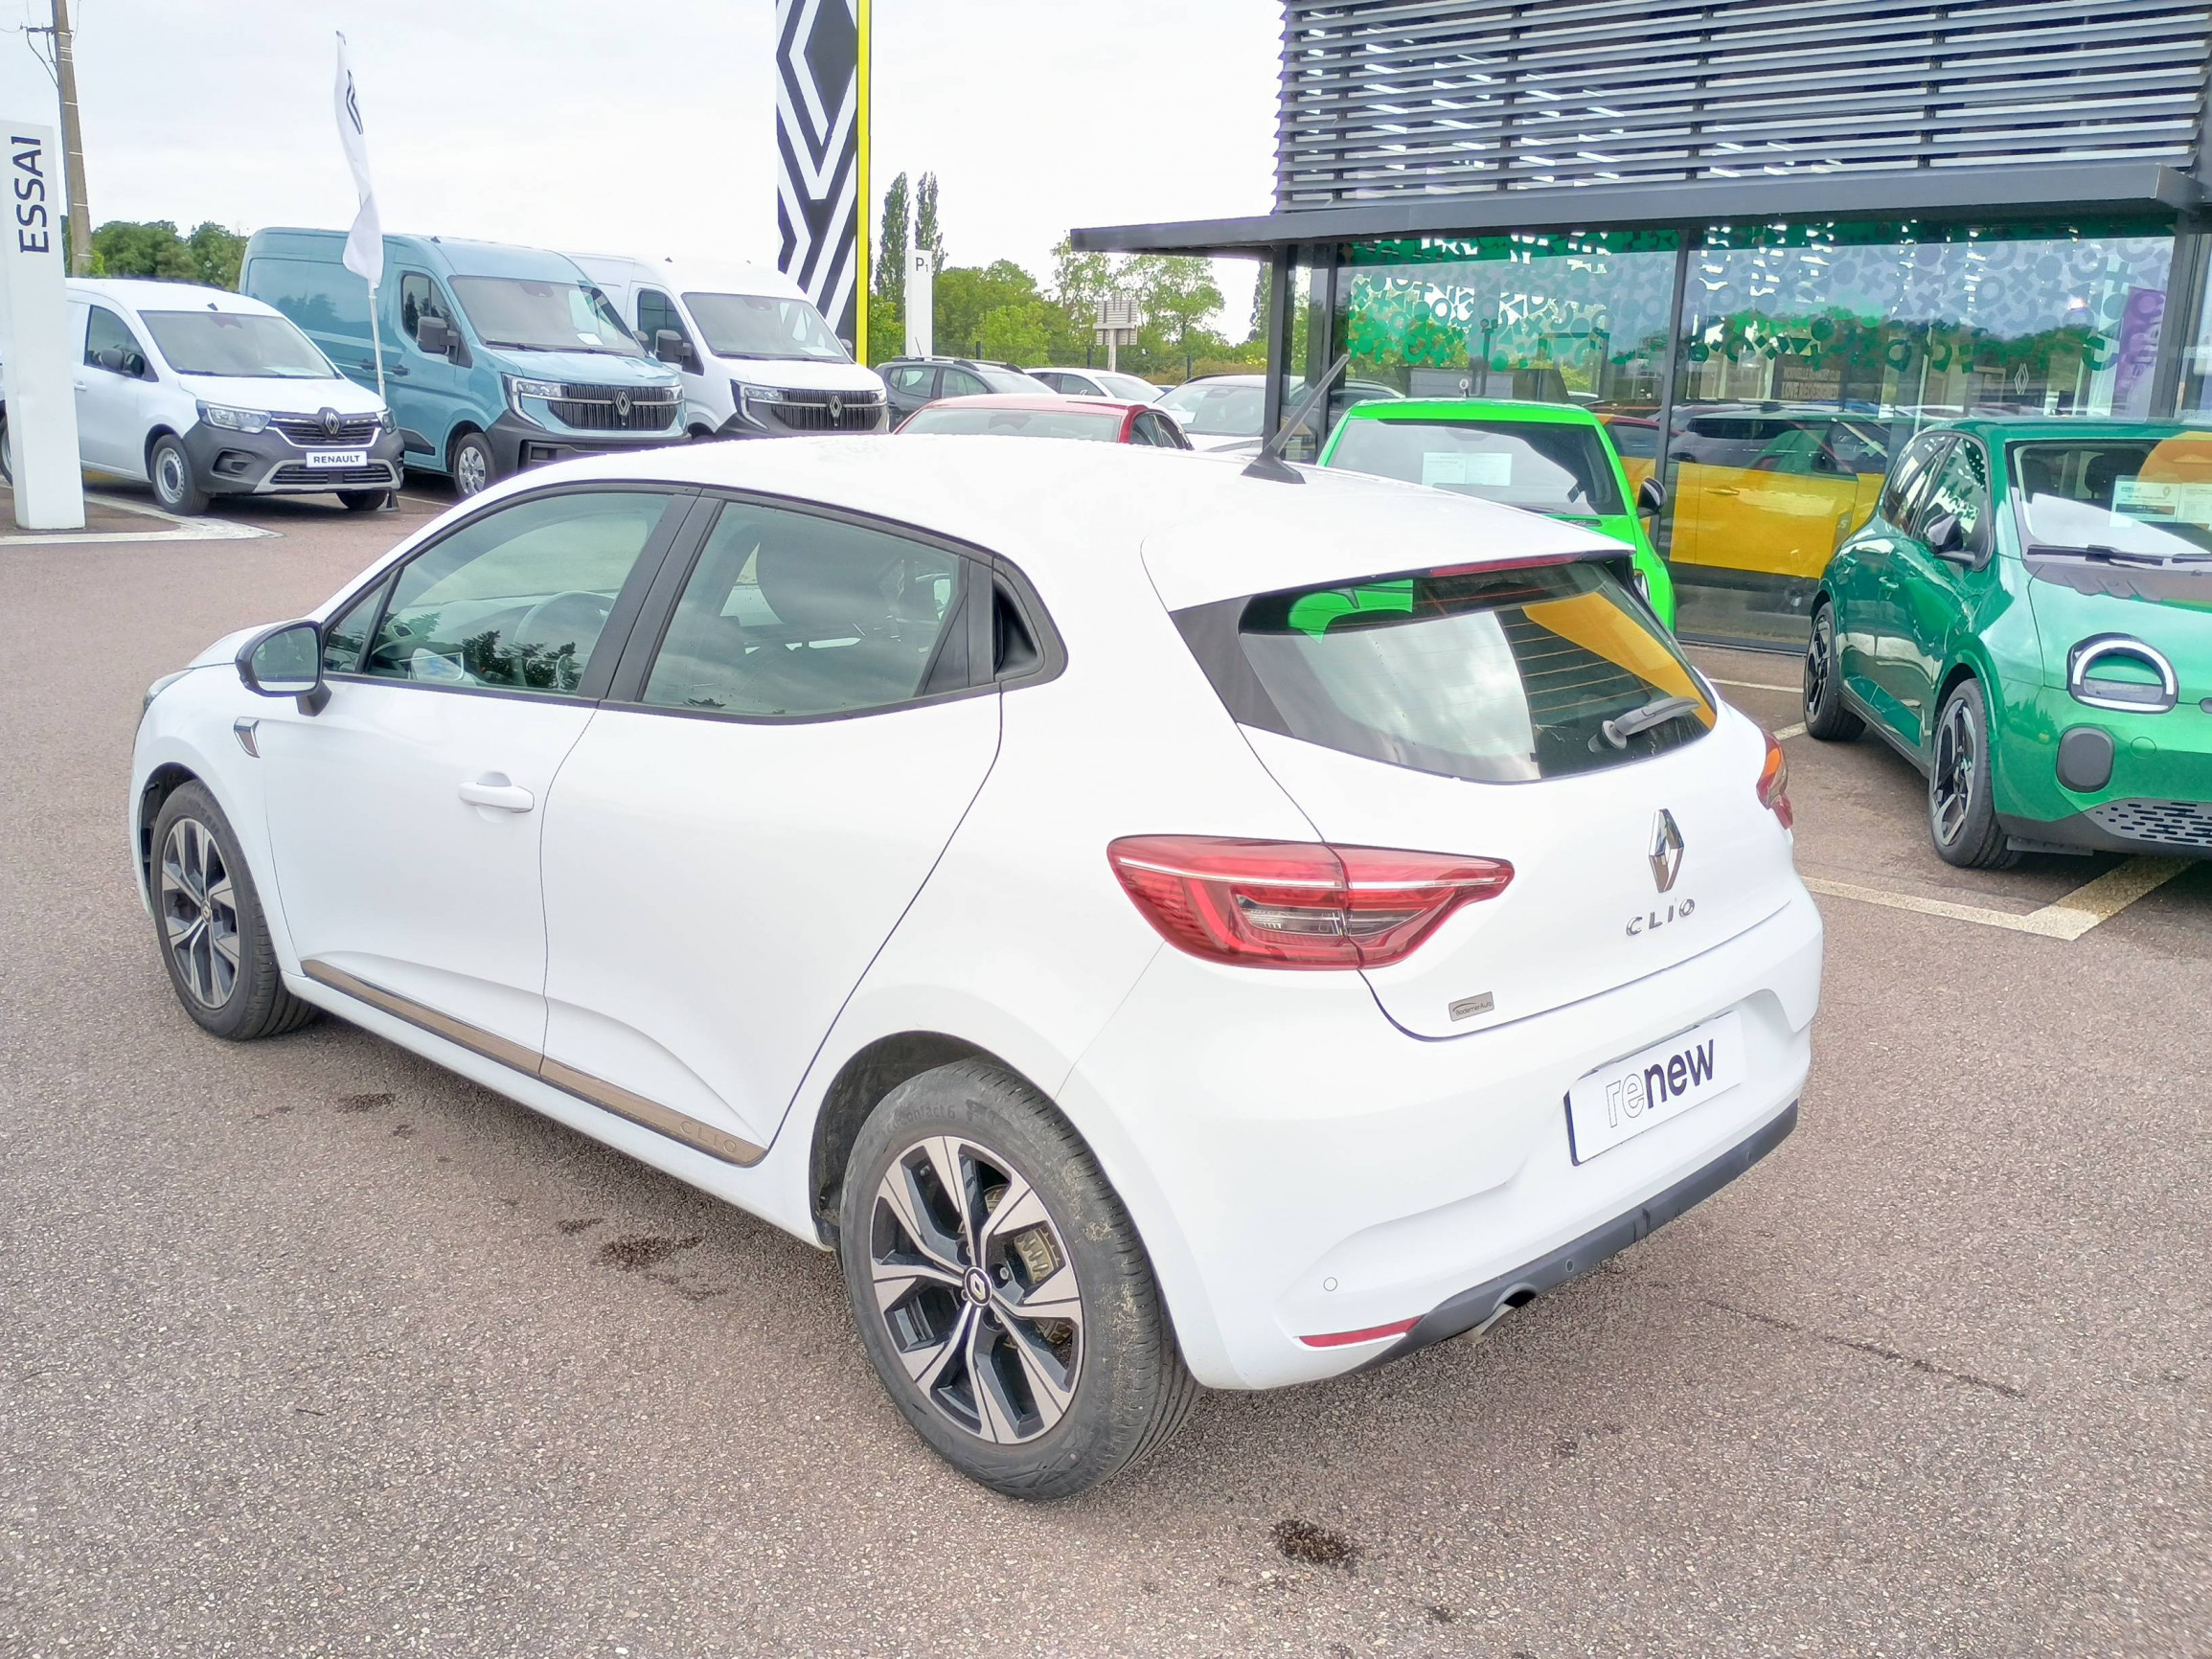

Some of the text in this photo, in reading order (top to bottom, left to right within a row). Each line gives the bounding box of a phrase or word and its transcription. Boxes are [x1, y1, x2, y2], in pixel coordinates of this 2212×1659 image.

[11, 136, 49, 253] ESSAI
[313, 455, 360, 464] RENAULT
[1626, 898, 1695, 936] CLIO
[1606, 1038, 1714, 1127] renew
[679, 1120, 737, 1155] CLIO
